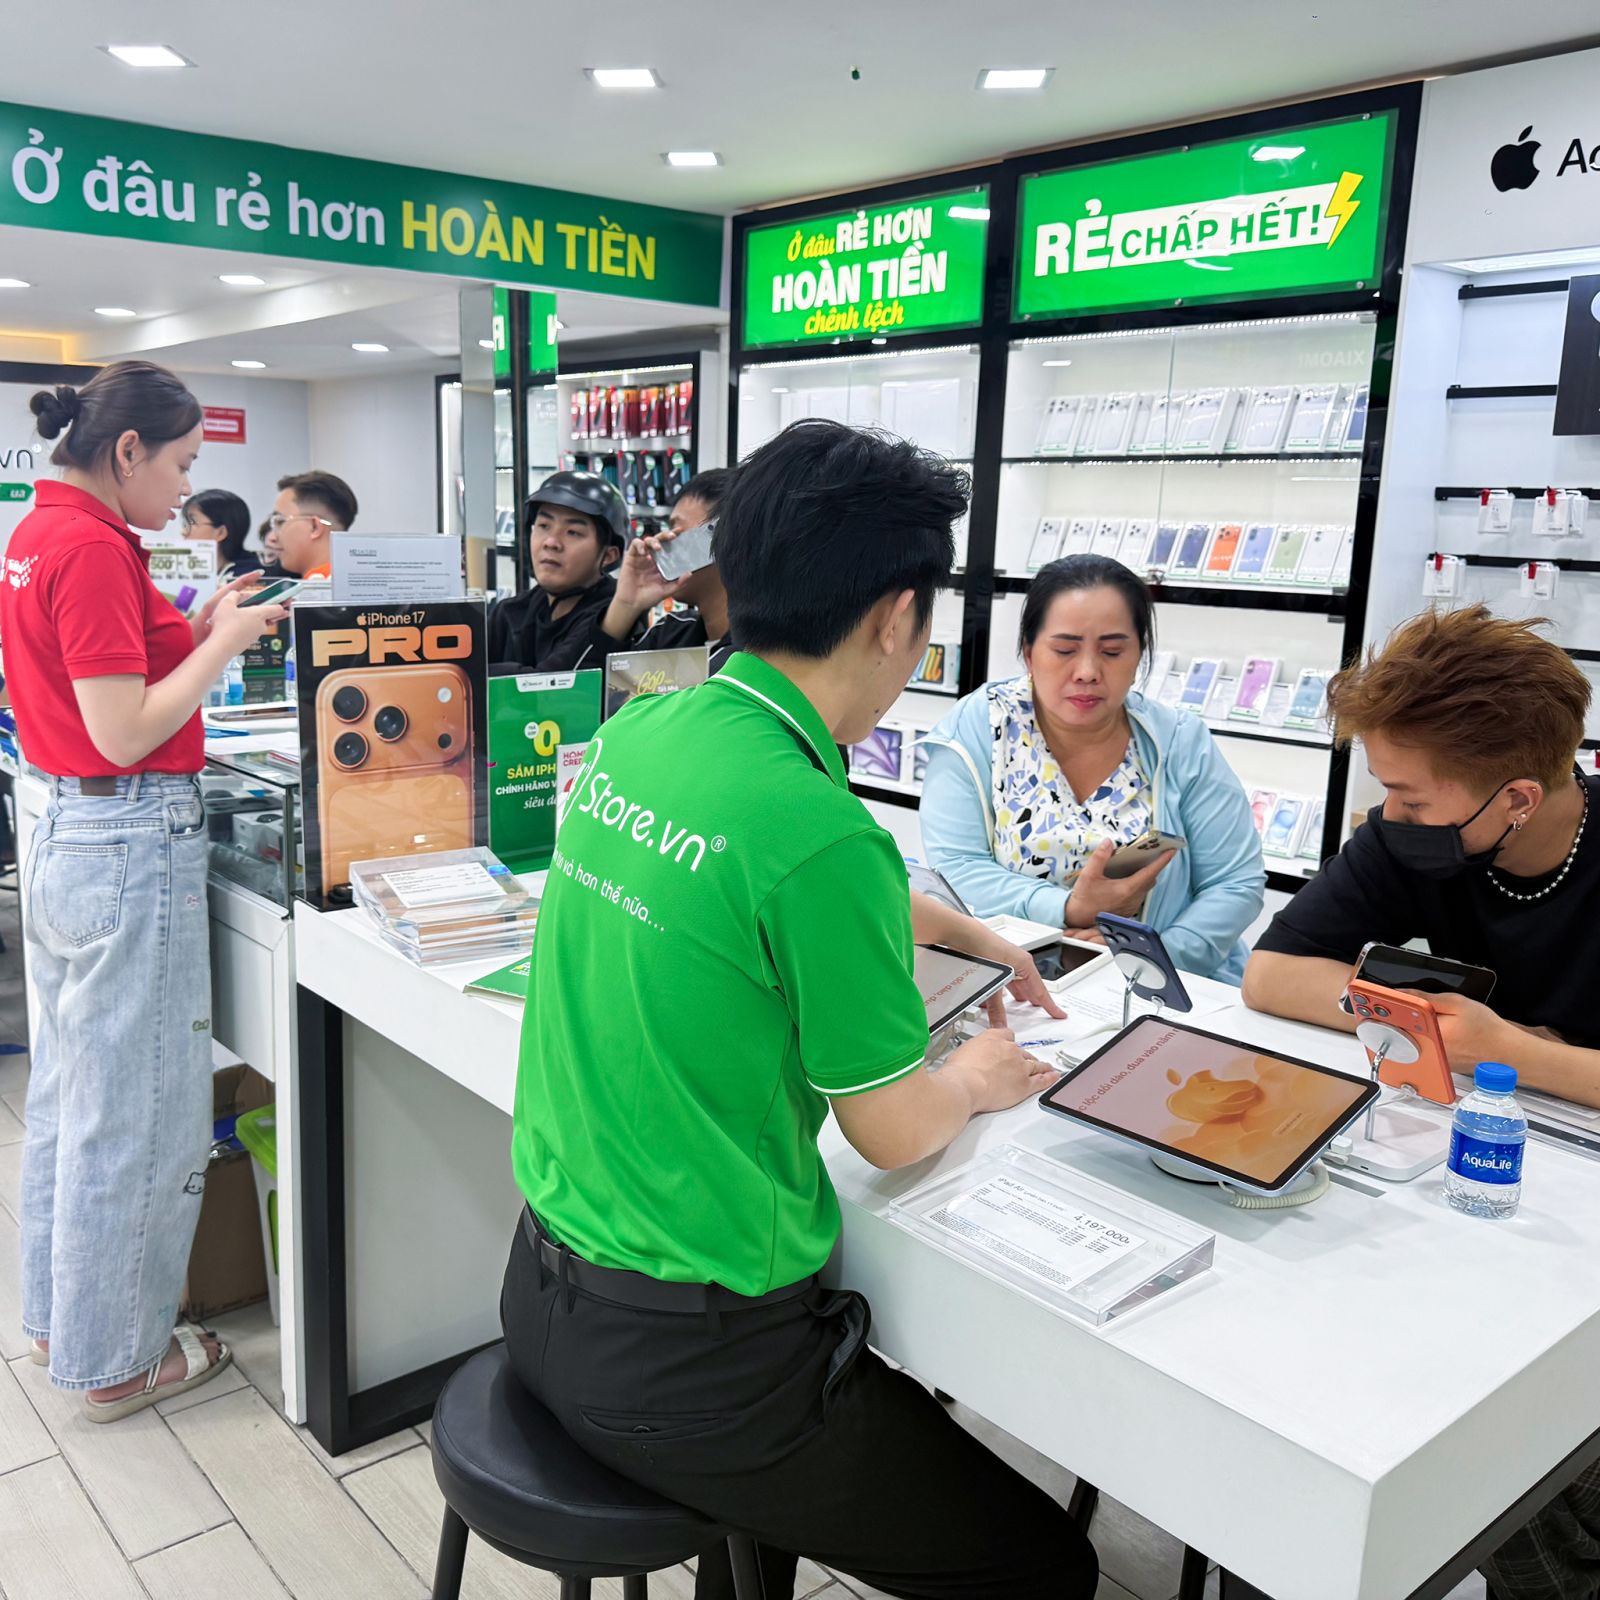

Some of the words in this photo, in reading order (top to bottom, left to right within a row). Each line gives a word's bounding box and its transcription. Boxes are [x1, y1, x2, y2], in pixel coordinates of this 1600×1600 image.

[12, 127, 63, 204] Ở
[82, 155, 196, 222] đâu
[215, 171, 270, 231] rẻ
[288, 182, 385, 245] hơn
[402, 200, 544, 266] HOÀN
[556, 215, 656, 280] TIỀN
[787, 230, 803, 262] Ở
[803, 233, 836, 259] đâu
[836, 210, 869, 253] RẺ
[873, 207, 932, 247] HƠN
[1034, 197, 1109, 277] RẺ
[1120, 210, 1219, 259] CHẤP
[1229, 197, 1320, 246] HẾT!
[772, 259, 861, 313] HOÀN
[867, 240, 947, 300] TIỀN
[804, 305, 859, 335] chênh
[863, 300, 904, 332] lệch
[368, 612, 411, 625] iPhone
[413, 611, 426, 624] 17
[312, 624, 472, 666] PRO
[536, 764, 556, 775] IPH
[495, 783, 523, 795] CHÍNH
[523, 796, 545, 809] siêu
[1462, 1152, 1512, 1170] AquaLife
